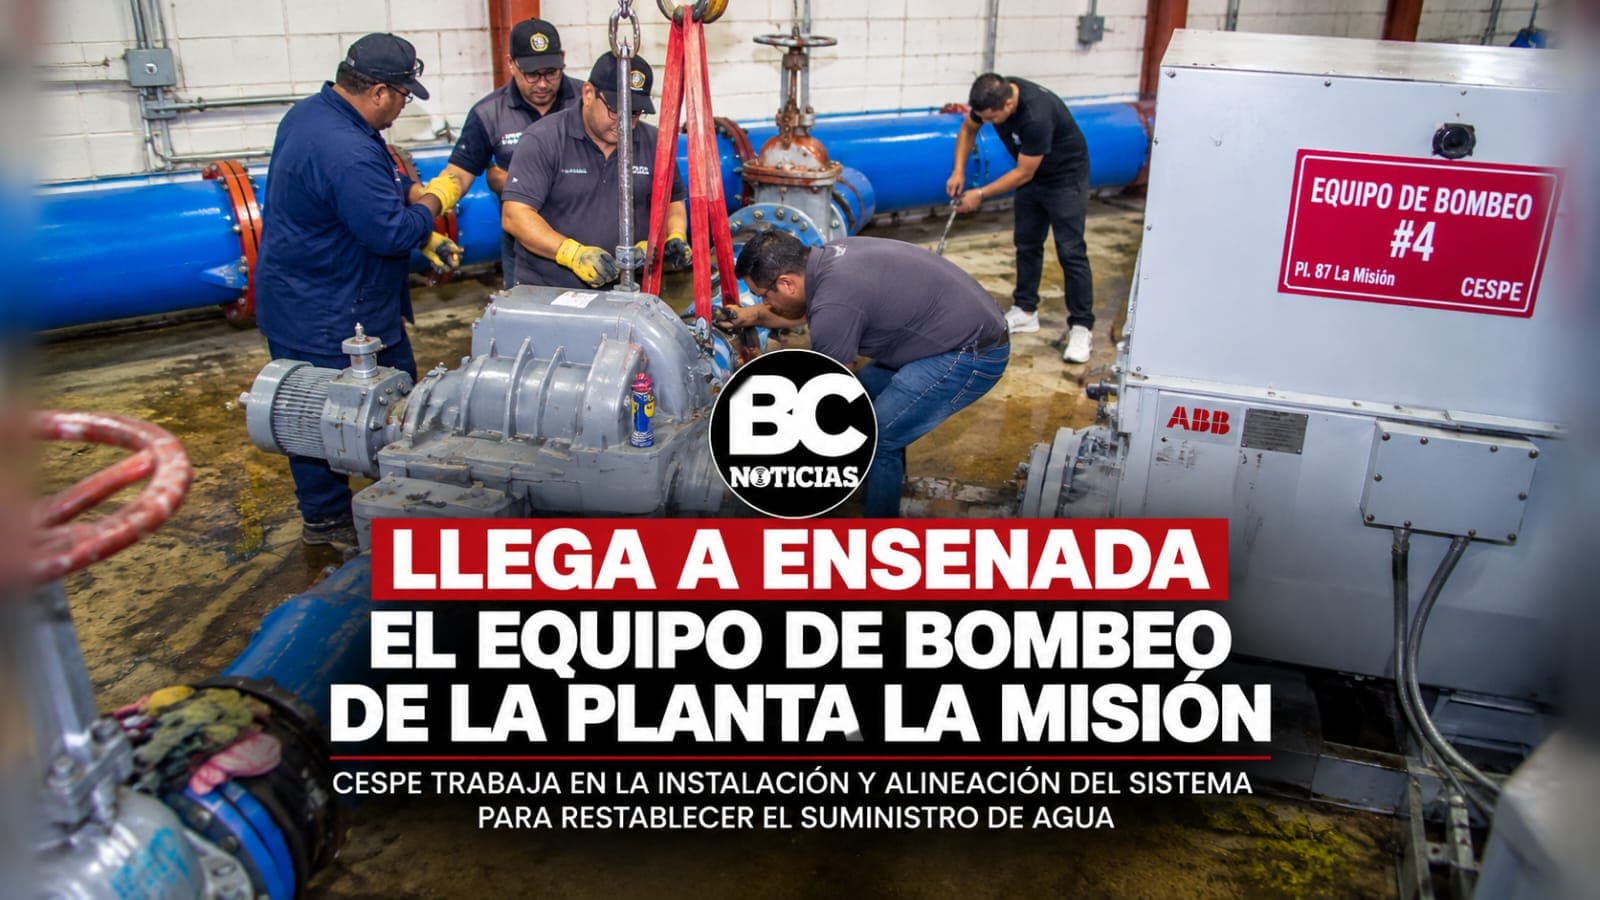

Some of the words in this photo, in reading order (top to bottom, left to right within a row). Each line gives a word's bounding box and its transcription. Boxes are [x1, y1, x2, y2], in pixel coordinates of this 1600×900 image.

[1311, 177, 1393, 209] EQUIPO
[1398, 184, 1430, 212] DE
[1434, 188, 1533, 221] BOMBEO
[1390, 219, 1436, 262] #4
[1315, 263, 1332, 280] 87
[1334, 265, 1350, 282] La
[1353, 267, 1395, 287] Misión
[1461, 277, 1524, 302] CESPE
[1166, 405, 1231, 435] ABB
